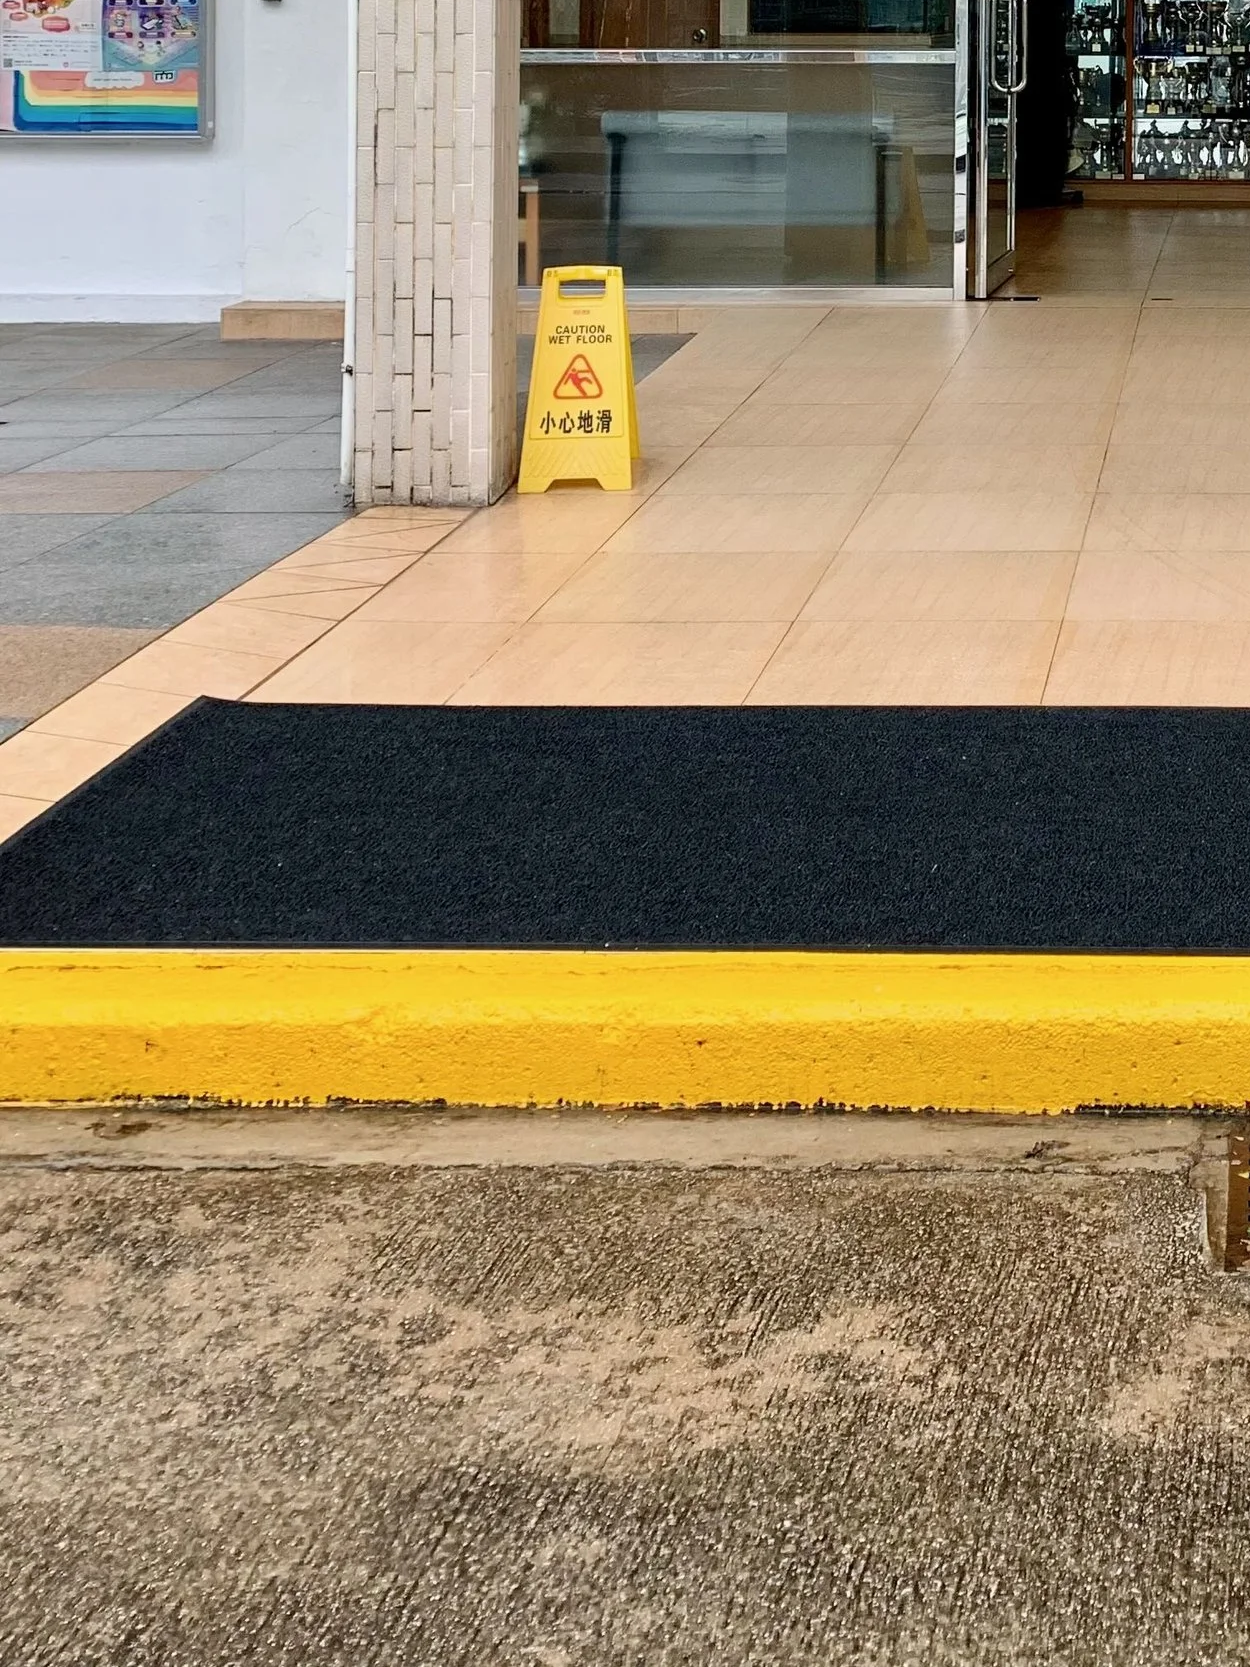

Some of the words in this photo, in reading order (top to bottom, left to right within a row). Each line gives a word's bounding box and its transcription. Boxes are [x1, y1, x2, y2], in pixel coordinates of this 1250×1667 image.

[555, 324, 606, 335] CAUTION
[548, 335, 572, 345] WET
[576, 334, 613, 344] FLOOR
[539, 409, 613, 435] 小心地滑
